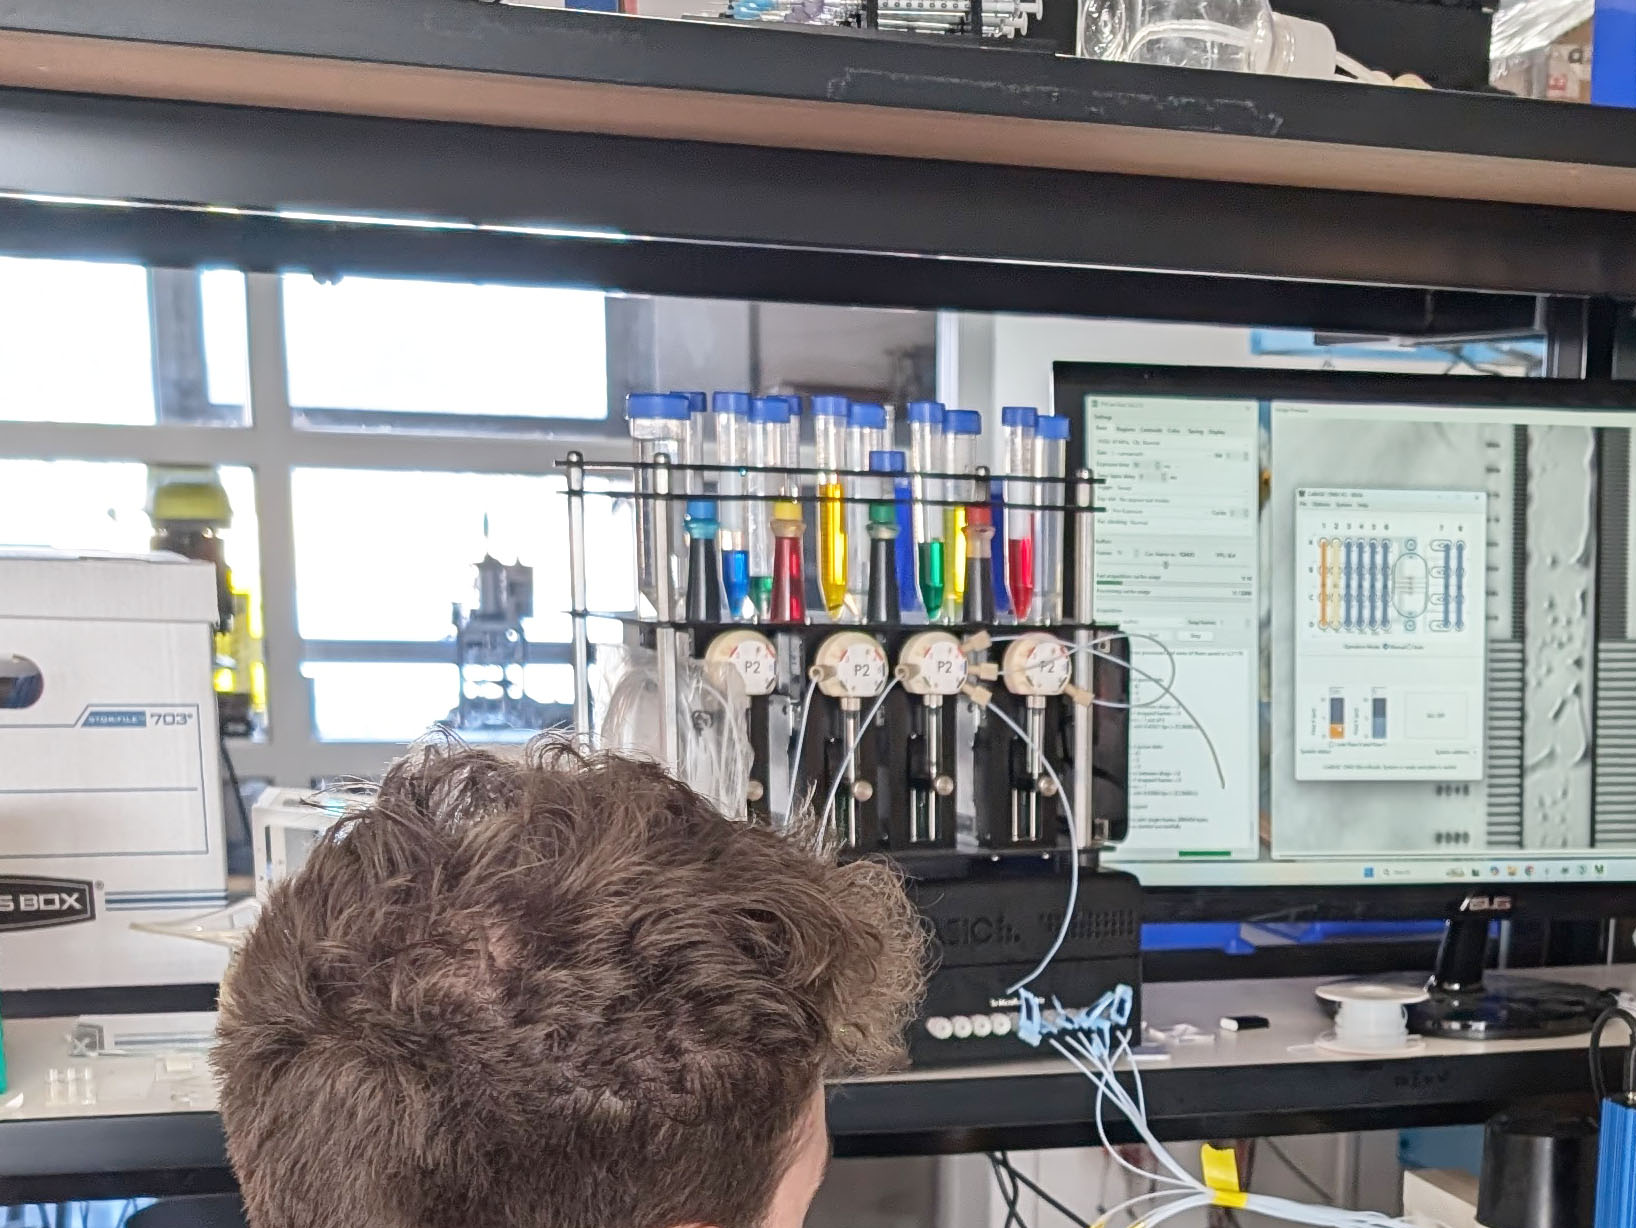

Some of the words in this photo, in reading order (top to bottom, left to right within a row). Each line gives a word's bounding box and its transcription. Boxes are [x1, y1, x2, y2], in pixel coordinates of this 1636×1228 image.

[744, 661, 761, 674] P2
[854, 663, 870, 676] P2
[936, 661, 952, 674] P2
[20, 892, 82, 911] BOX
